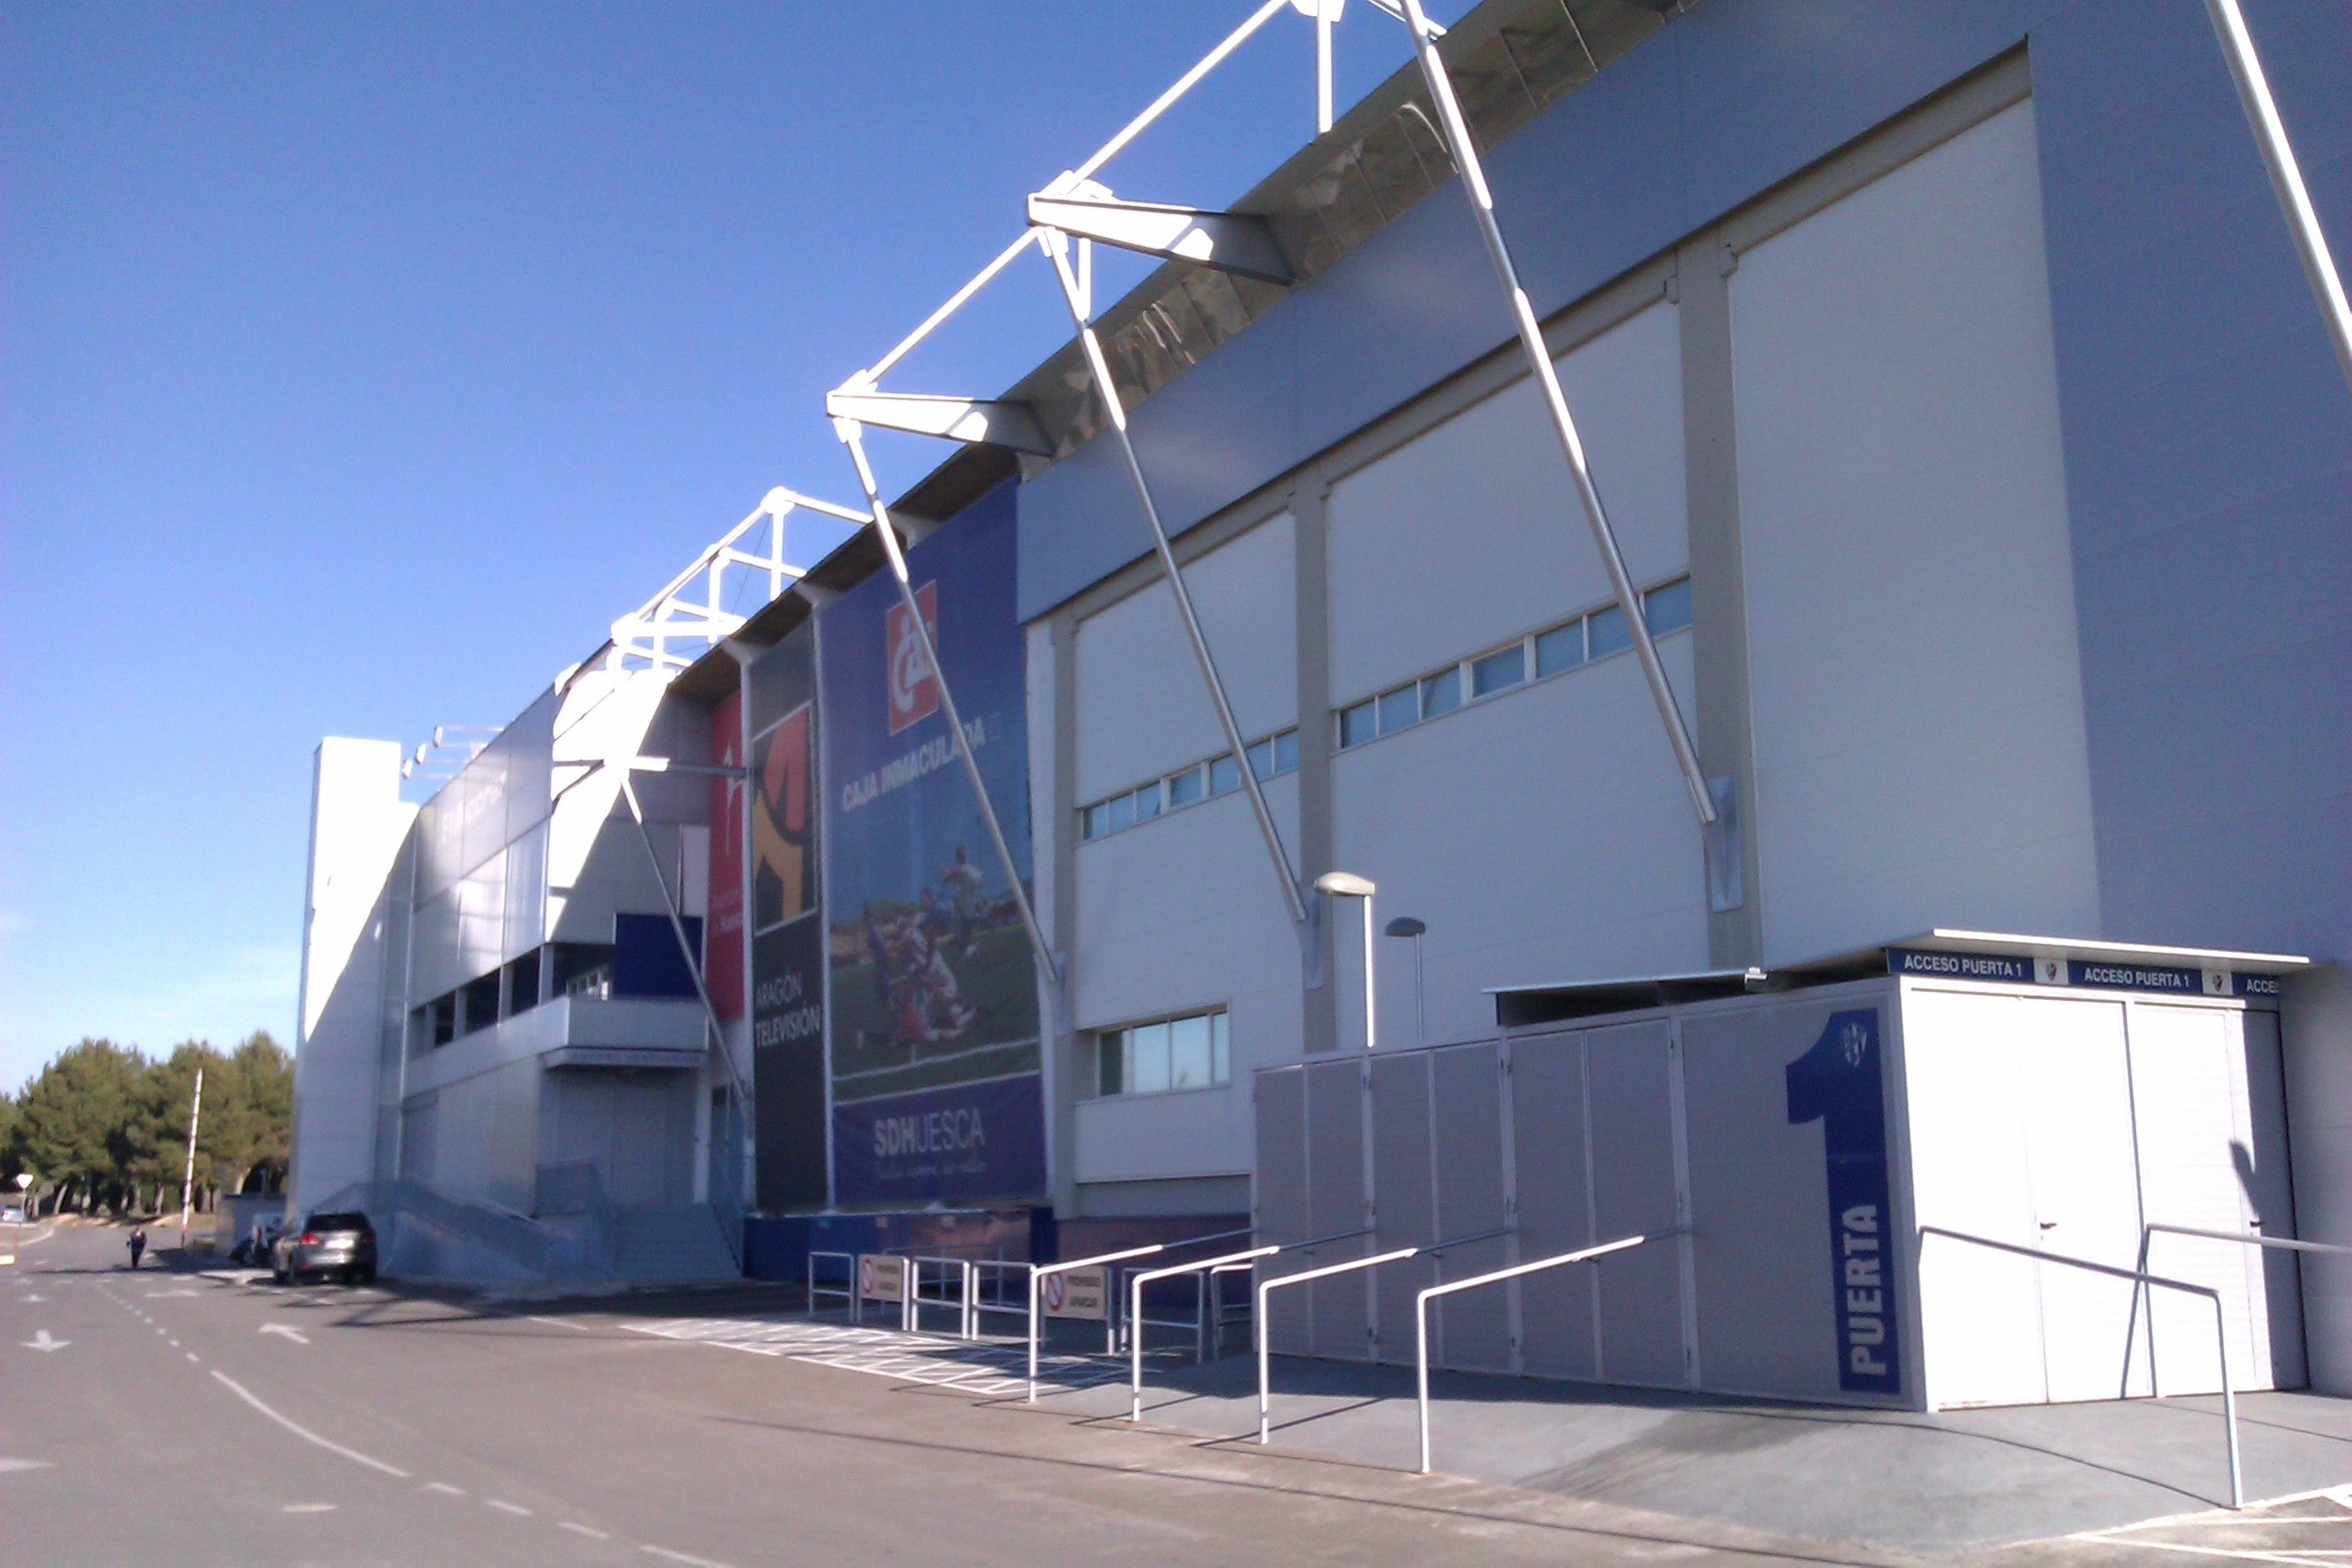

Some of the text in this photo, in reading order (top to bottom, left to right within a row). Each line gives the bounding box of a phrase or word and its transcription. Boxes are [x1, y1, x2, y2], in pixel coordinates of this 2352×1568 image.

[843, 772, 878, 812] CAJA
[1905, 955, 2023, 977] ACCESO PUERTA 1
[2084, 967, 2190, 988] ACCESO PUERTA 1
[1786, 1007, 1900, 1395] 1
[1841, 1203, 1888, 1377] PUERTA
